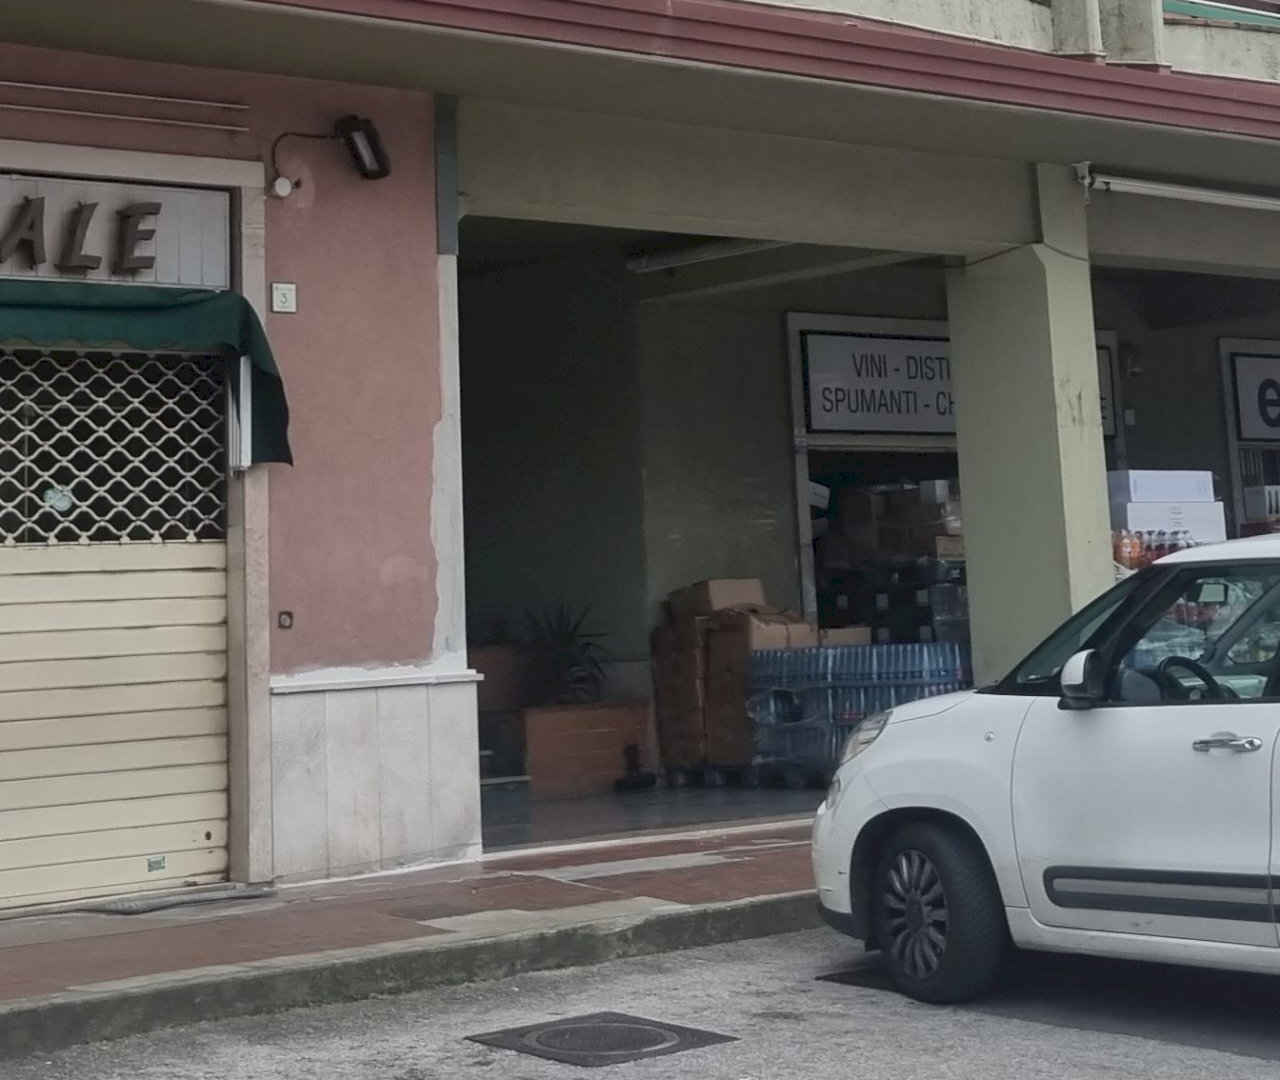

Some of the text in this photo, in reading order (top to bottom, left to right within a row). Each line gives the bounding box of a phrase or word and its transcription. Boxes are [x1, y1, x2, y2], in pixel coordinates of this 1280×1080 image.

[280, 292, 288, 304] 3
[851, 352, 888, 379] VINI
[821, 386, 919, 415] SPUMANTI
